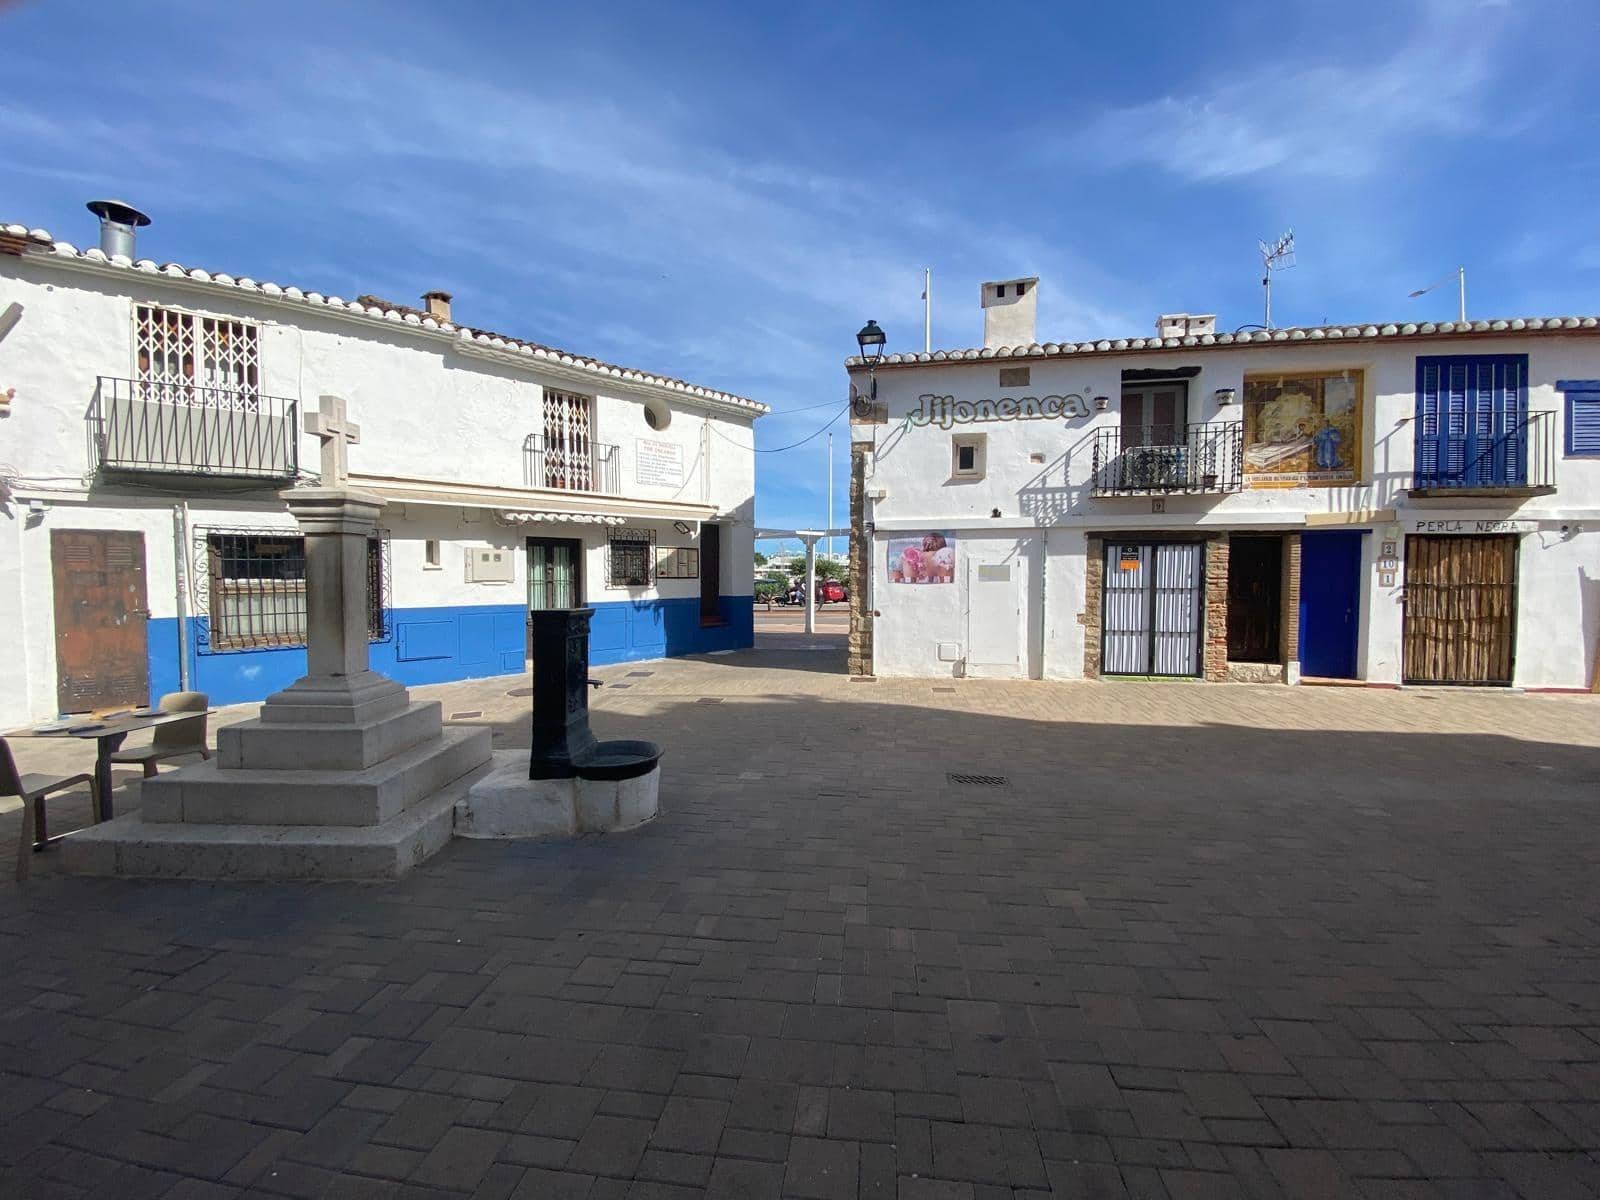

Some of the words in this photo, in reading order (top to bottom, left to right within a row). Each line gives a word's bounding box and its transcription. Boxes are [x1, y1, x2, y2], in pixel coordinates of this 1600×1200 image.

[911, 394, 1090, 430] Jijonenca
[1416, 521, 1463, 532] PERLA
[1475, 521, 1519, 532] NEGRA
[1385, 545, 1392, 554] 2
[1383, 560, 1394, 568] 10
